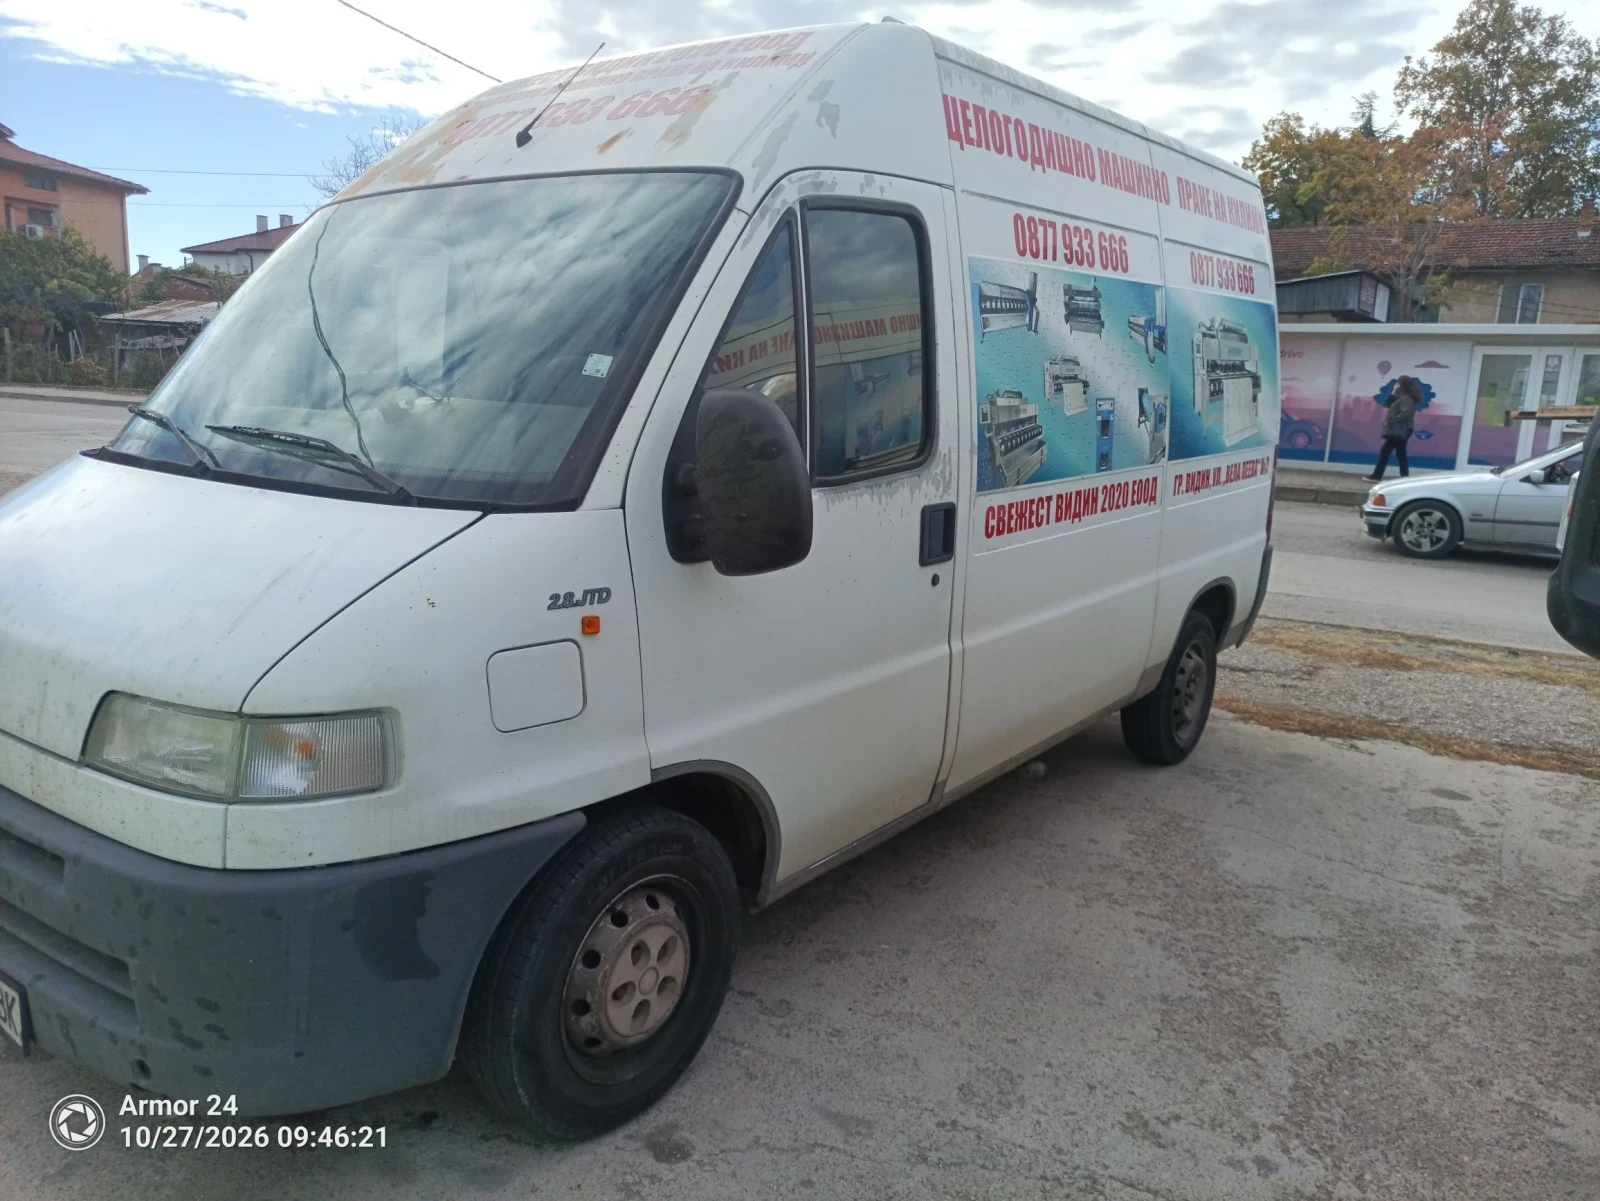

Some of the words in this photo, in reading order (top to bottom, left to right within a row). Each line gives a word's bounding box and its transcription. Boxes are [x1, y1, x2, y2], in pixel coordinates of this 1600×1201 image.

[725, 31, 817, 55] ЕООД
[603, 84, 712, 122] 666
[941, 92, 1096, 183] ЦЕЛОГОДИШНО
[1097, 147, 1170, 206] МАШИННО
[1176, 175, 1213, 219] ПРАНЕ
[1213, 190, 1228, 223] НА
[1013, 212, 1058, 262] 0877
[1061, 223, 1095, 269] 933
[1097, 231, 1129, 273] 666
[1189, 251, 1216, 287] 0877
[1216, 256, 1236, 292] 933
[1237, 262, 1255, 294] 666
[1173, 474, 1185, 497] ГР.
[1185, 468, 1212, 495] ВИДИН,
[984, 496, 1053, 539] СВЕЖЕСТ
[1055, 486, 1099, 524] ВИДИН
[1100, 482, 1129, 513] 2020
[1131, 476, 1159, 507] ЕООД
